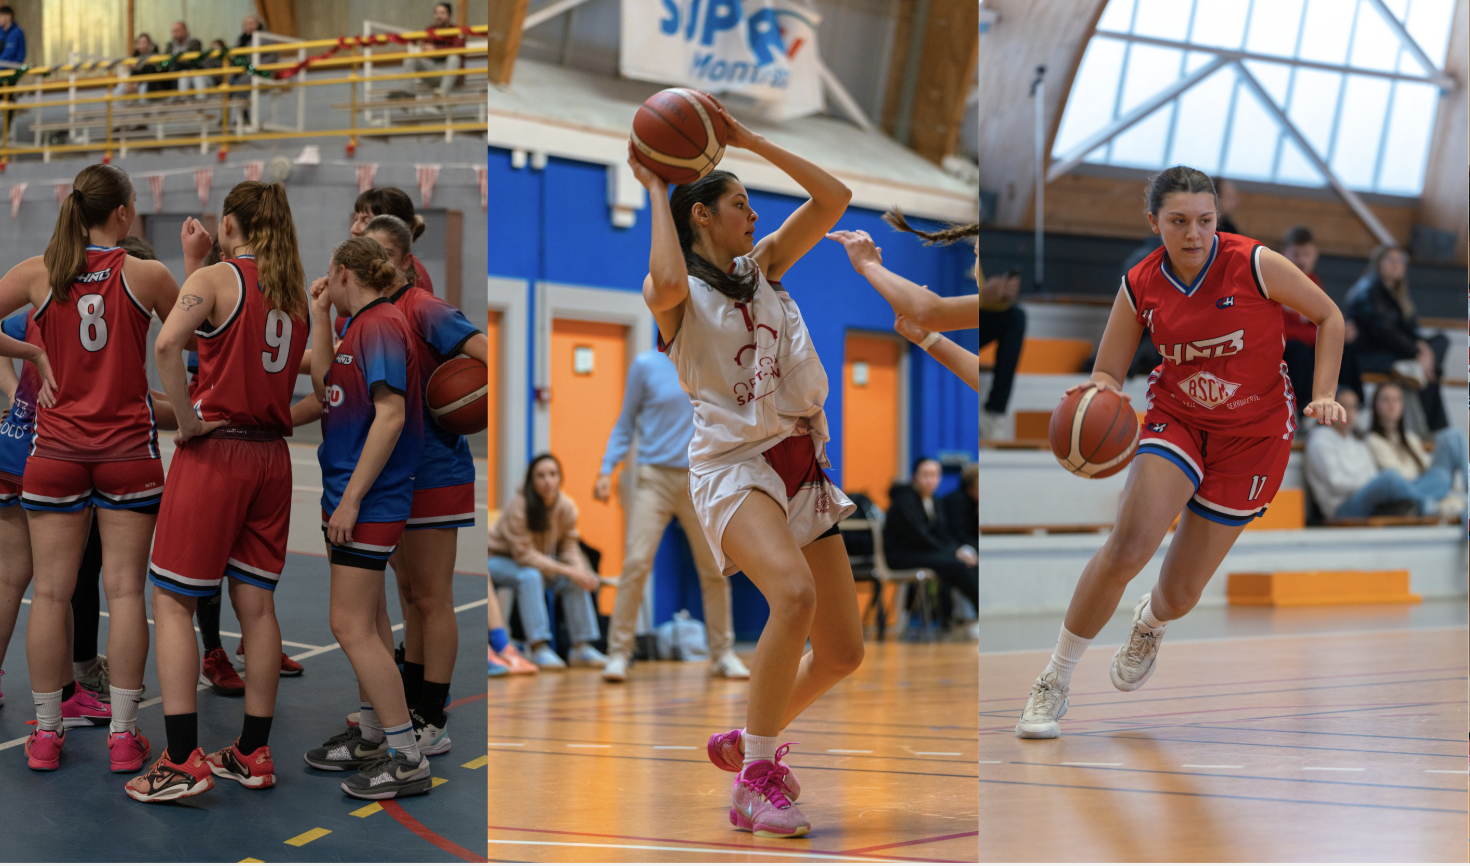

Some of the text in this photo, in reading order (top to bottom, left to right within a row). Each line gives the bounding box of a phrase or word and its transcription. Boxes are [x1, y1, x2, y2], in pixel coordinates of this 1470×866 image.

[77, 293, 108, 352] 8
[261, 308, 293, 374] 9
[1247, 474, 1268, 501] 11
